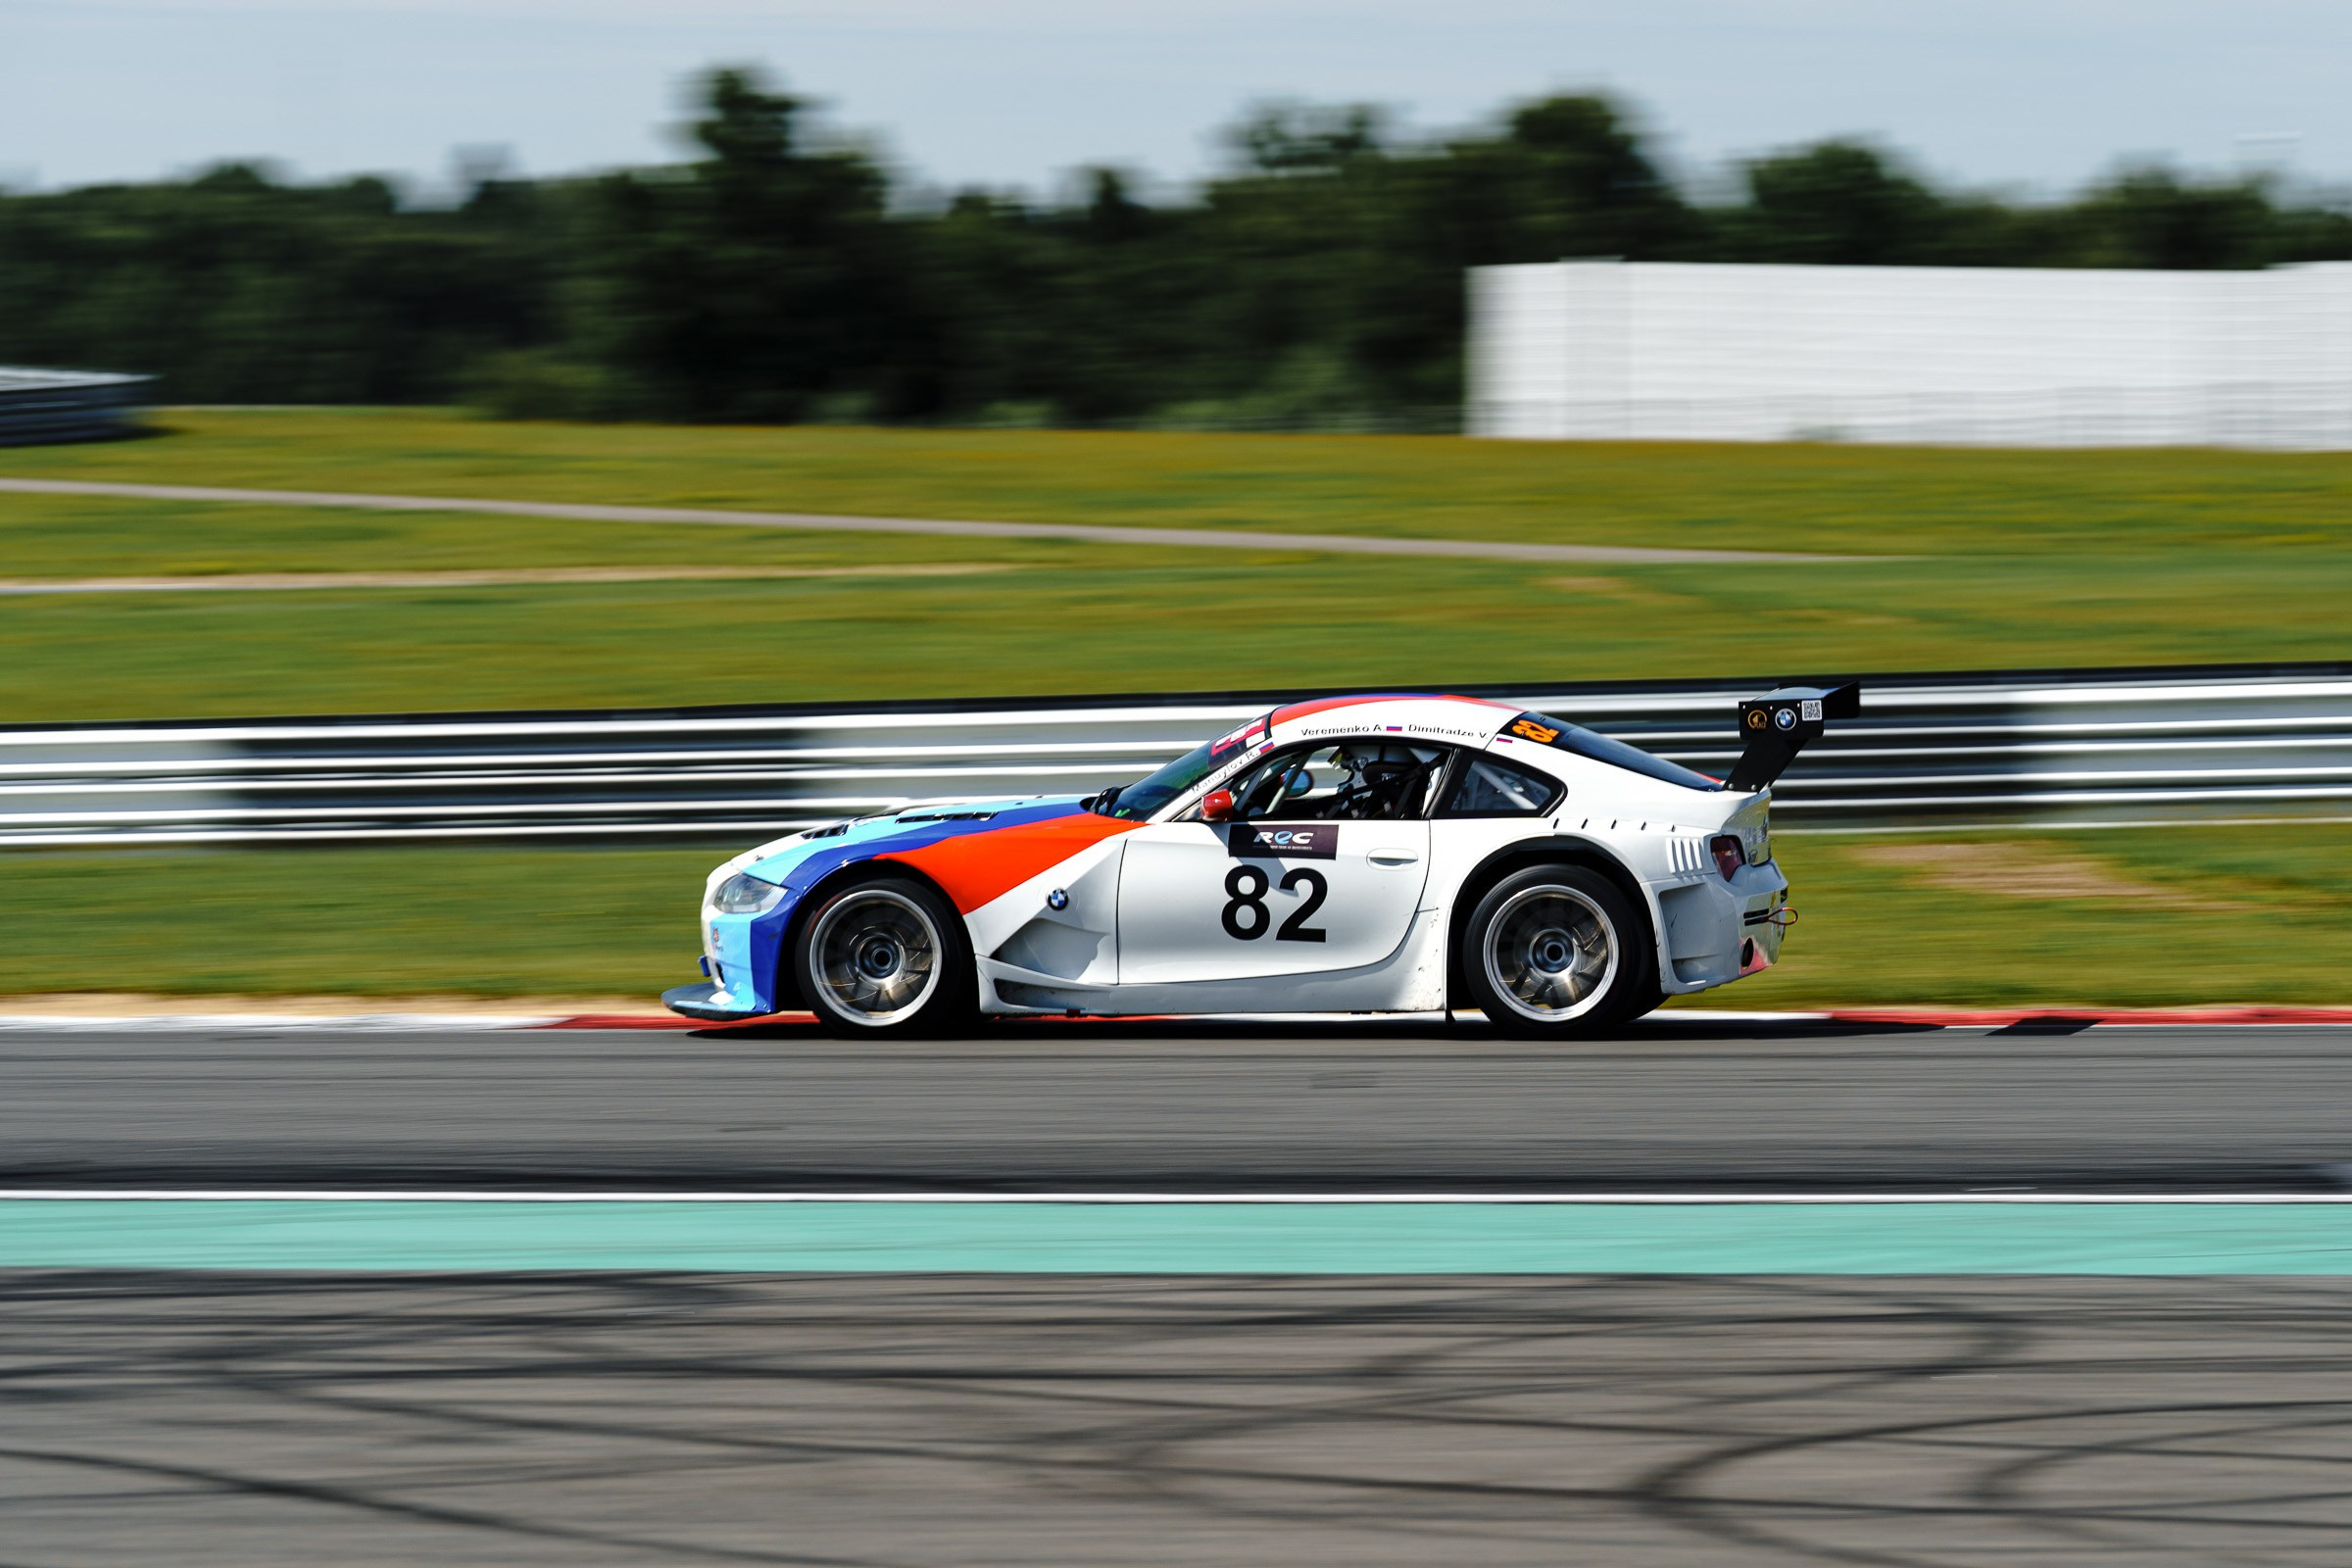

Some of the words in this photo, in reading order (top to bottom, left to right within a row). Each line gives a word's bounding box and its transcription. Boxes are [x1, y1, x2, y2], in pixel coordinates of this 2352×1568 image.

[1300, 725, 1369, 736] Veremenko
[1408, 724, 1474, 737] Dimitradze
[1512, 719, 1559, 743] 82
[1192, 760, 1243, 794] Manuylov
[1221, 864, 1328, 943] 82
